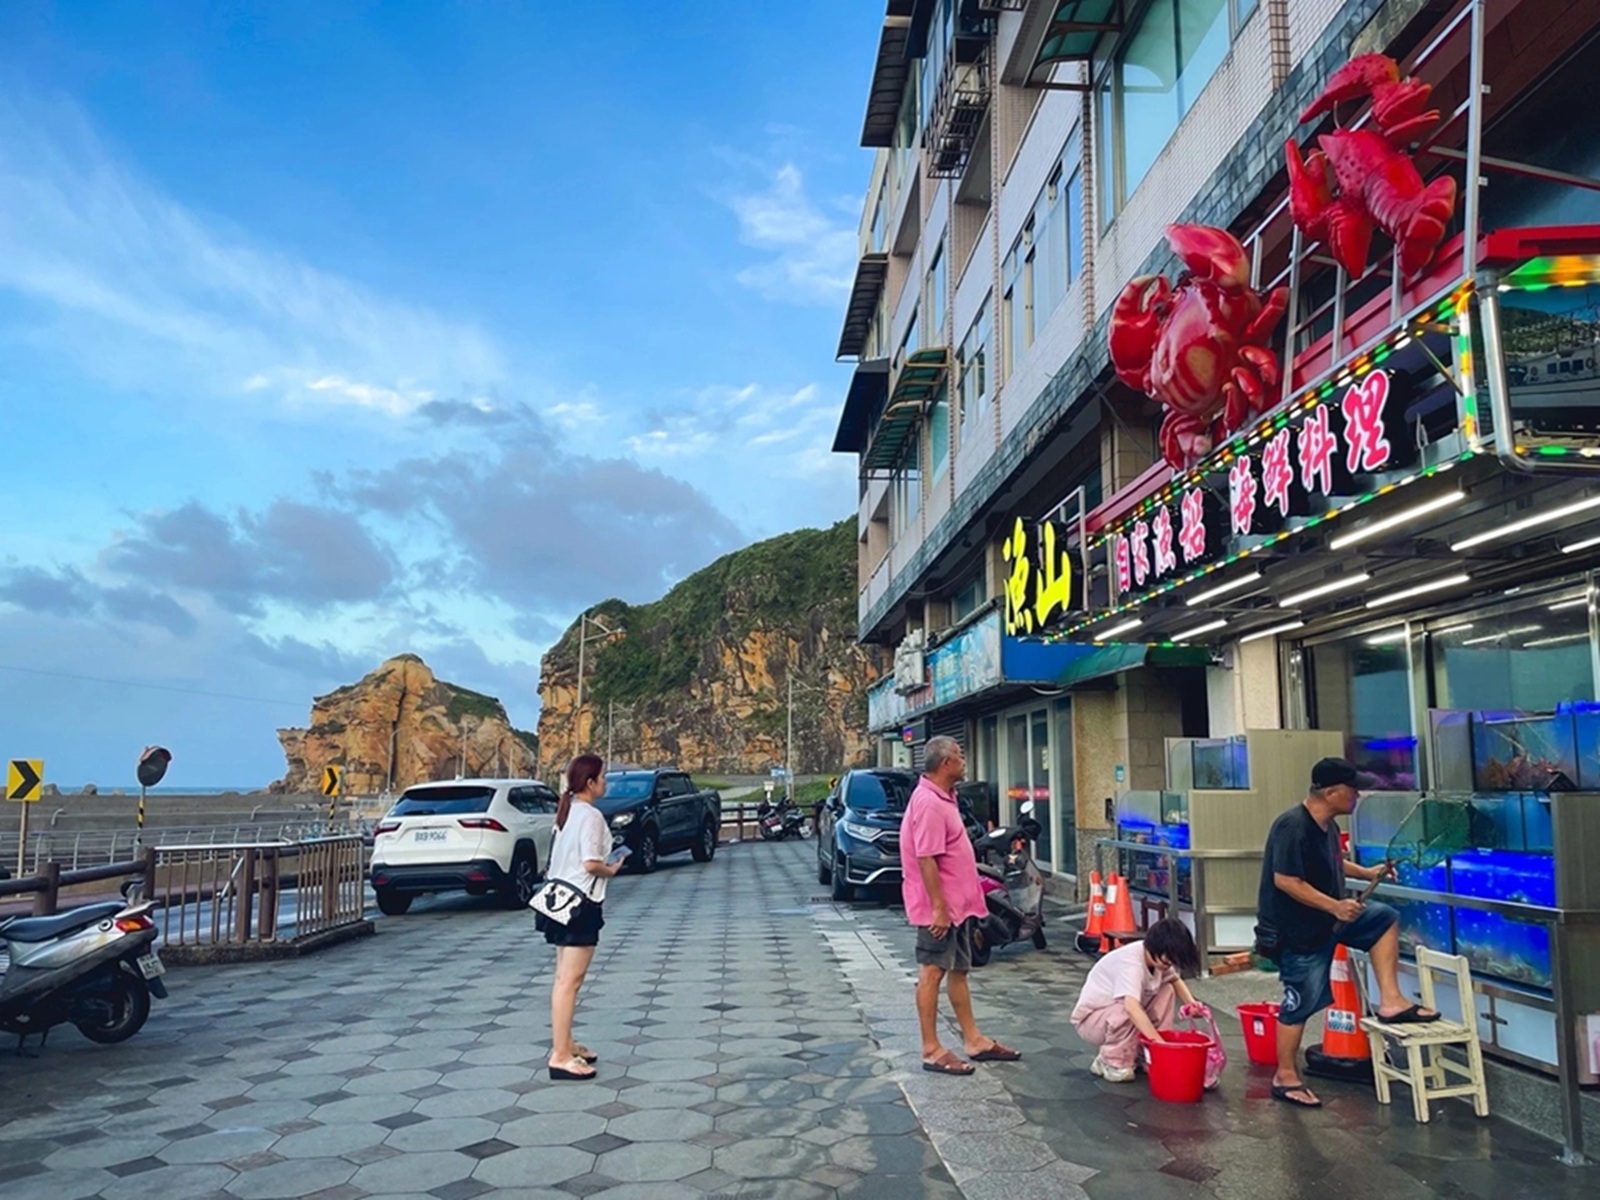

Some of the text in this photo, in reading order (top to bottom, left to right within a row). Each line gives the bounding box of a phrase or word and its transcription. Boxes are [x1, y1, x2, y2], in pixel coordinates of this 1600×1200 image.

[1229, 369, 1390, 535] 海鮮料理
[1003, 516, 1072, 637] 漁山
